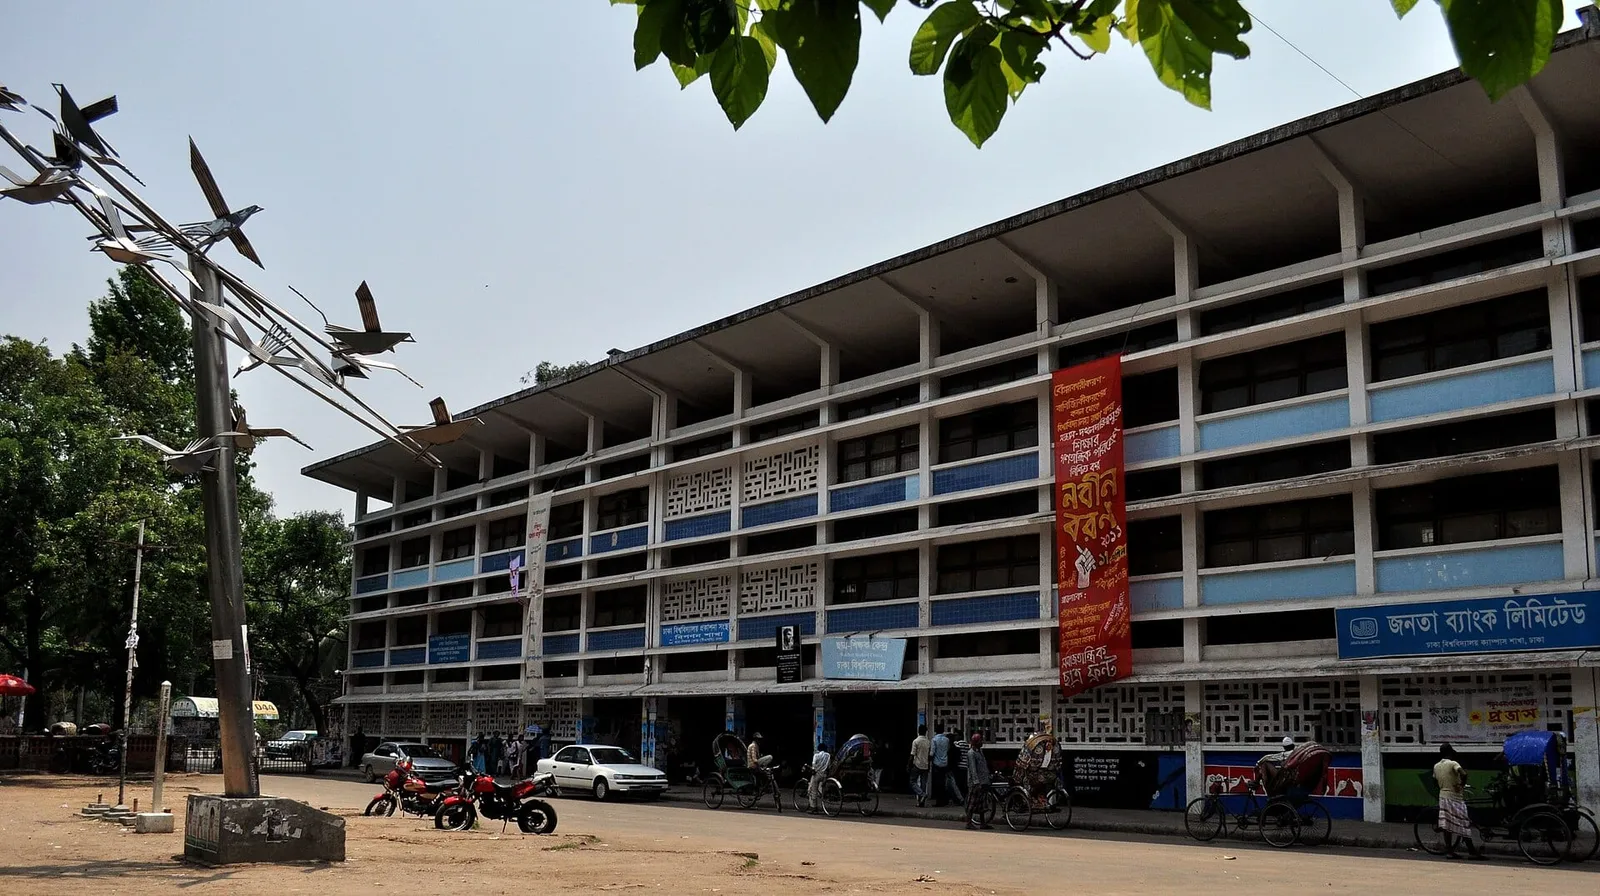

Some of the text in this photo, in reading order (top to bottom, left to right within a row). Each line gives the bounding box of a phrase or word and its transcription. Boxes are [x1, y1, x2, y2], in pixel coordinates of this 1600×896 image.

[1062, 468, 1117, 509] নবীন
[1062, 501, 1118, 542] বরণ
[1100, 525, 1122, 548] ২০১১
[1386, 596, 1587, 636] জনতা ব্যাংক লিমিটেড
[1425, 641, 1441, 649] ঢাকা
[1442, 639, 1479, 649] বিশ্ববিদ্যালয়
[1480, 638, 1507, 647] ক্যাম্পাস
[1528, 636, 1545, 644] ঢাকা
[1062, 655, 1118, 689] ছাত্র ফ্রন্ট
